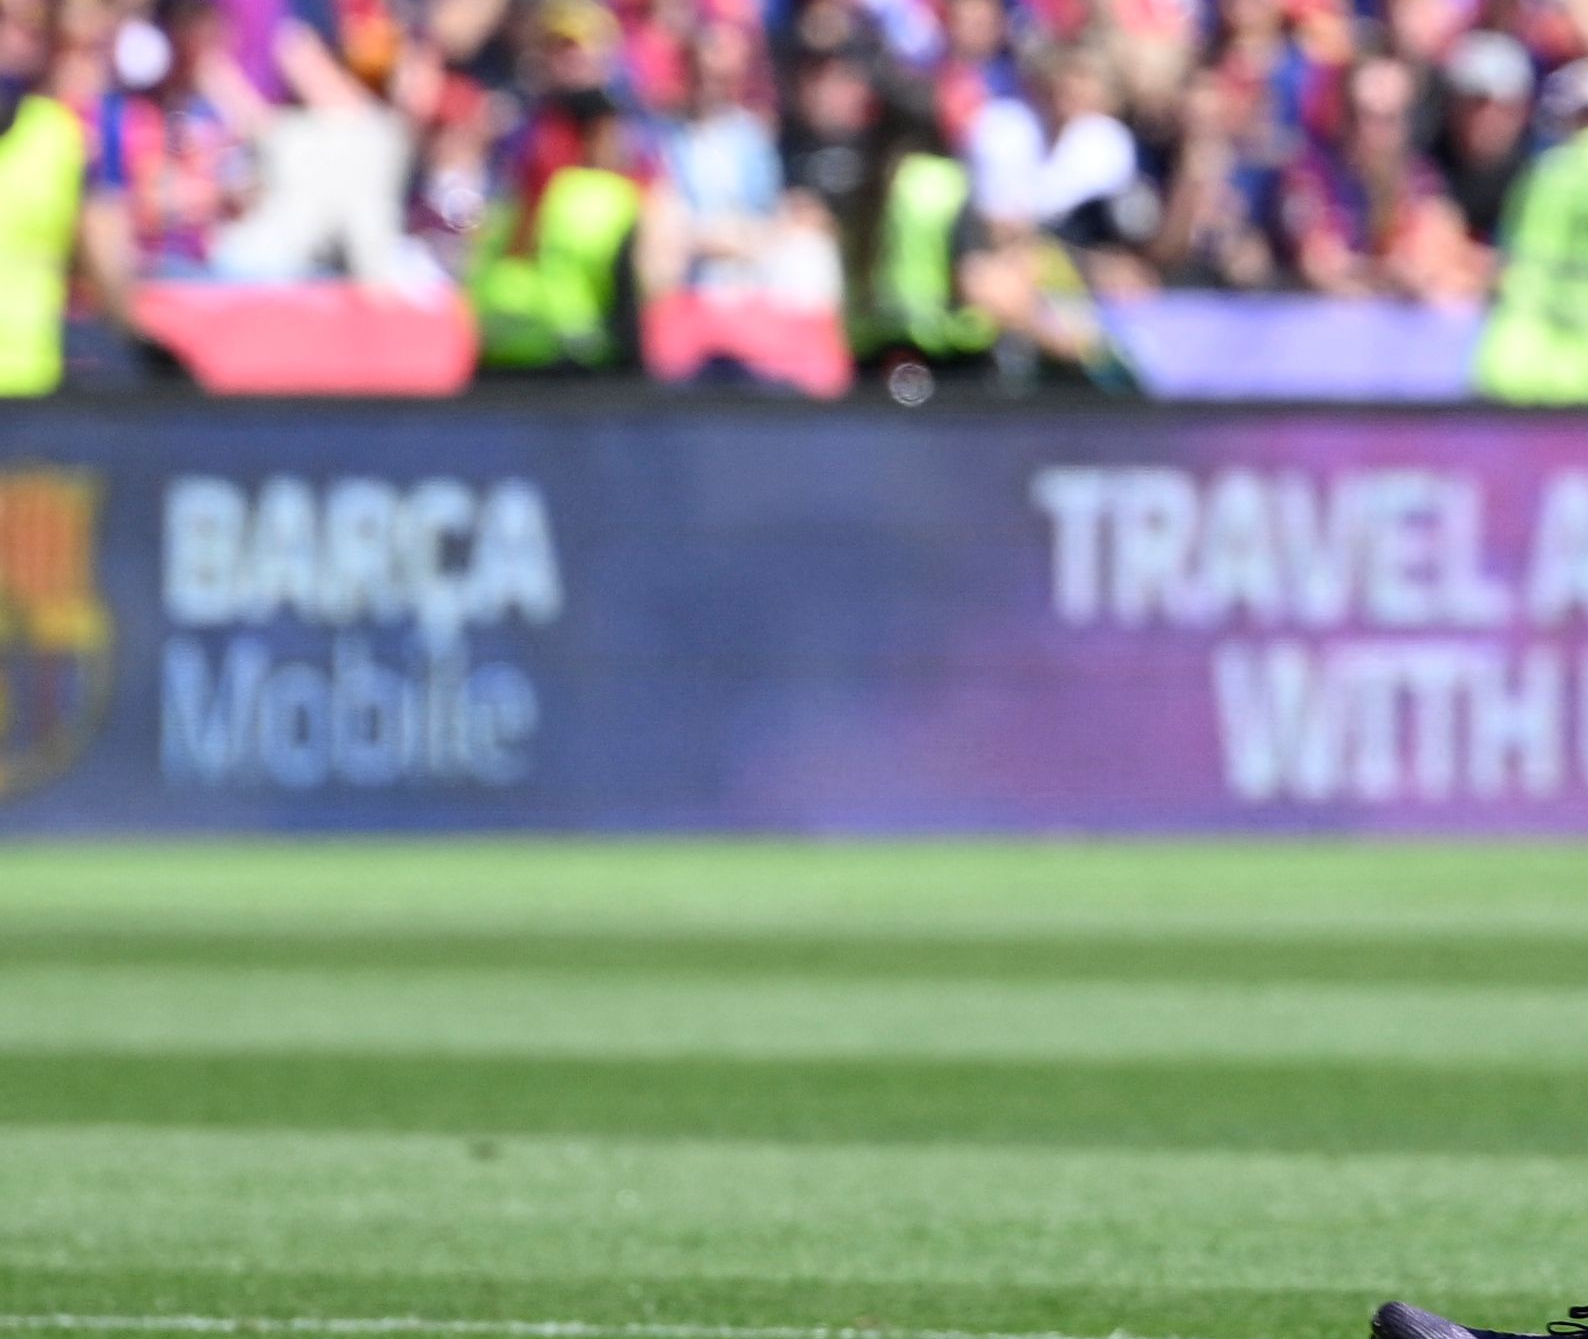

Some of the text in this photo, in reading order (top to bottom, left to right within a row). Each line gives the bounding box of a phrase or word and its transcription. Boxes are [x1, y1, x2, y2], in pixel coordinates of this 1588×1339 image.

[163, 475, 562, 658] BARÇA
[1033, 468, 1512, 627] TRAVEL
[163, 636, 540, 788] Mobile
[1212, 644, 1558, 800] WITH
